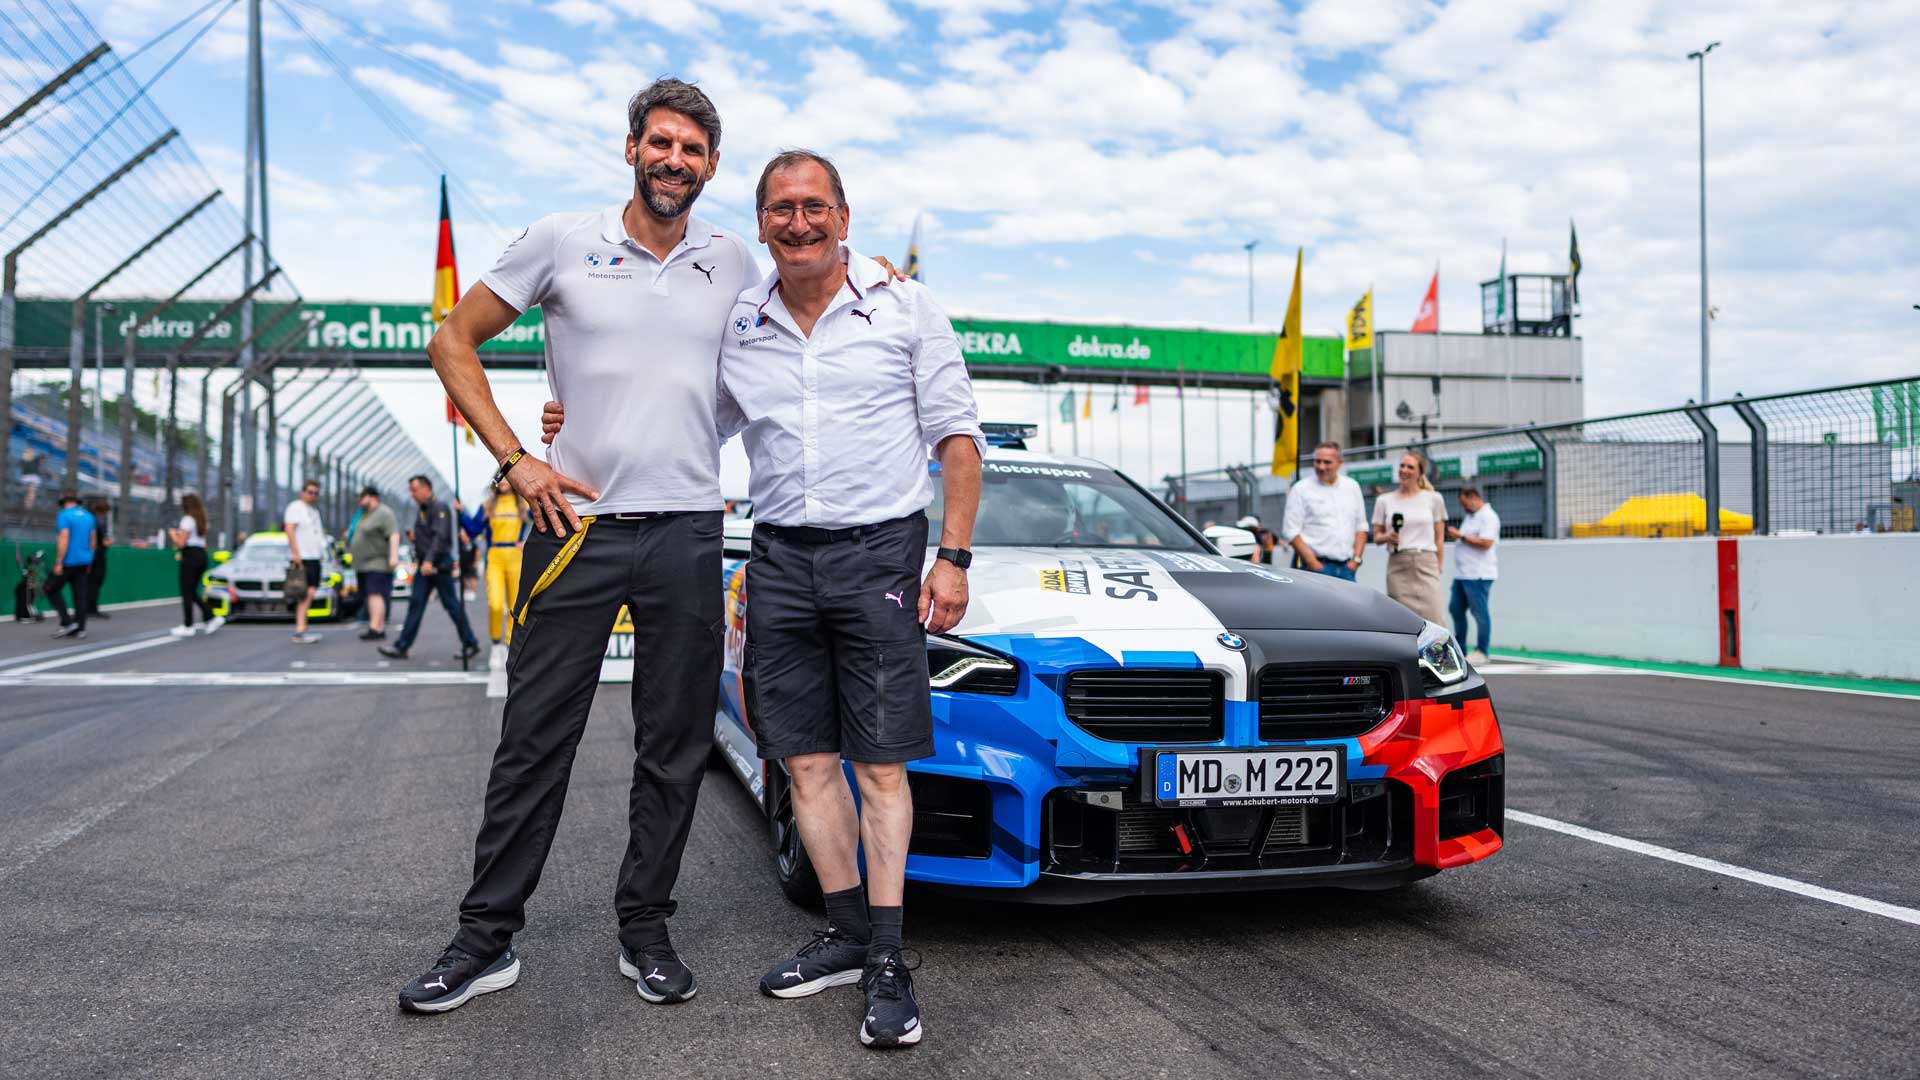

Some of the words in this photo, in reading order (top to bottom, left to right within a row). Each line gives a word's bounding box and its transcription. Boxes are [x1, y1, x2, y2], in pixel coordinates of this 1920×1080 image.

[587, 271, 633, 281] Motorsport
[300, 307, 439, 349] Techni
[739, 332, 778, 348] Motorsport
[1067, 334, 1152, 360] dekra.de
[1042, 569, 1063, 593] ADAC
[1066, 570, 1088, 593] BMW
[1163, 781, 1172, 792] D
[1179, 759, 1223, 795] MD
[1246, 757, 1267, 793] M
[1273, 756, 1333, 792] 222
[1222, 796, 1320, 807] www.schubert-motors.de
